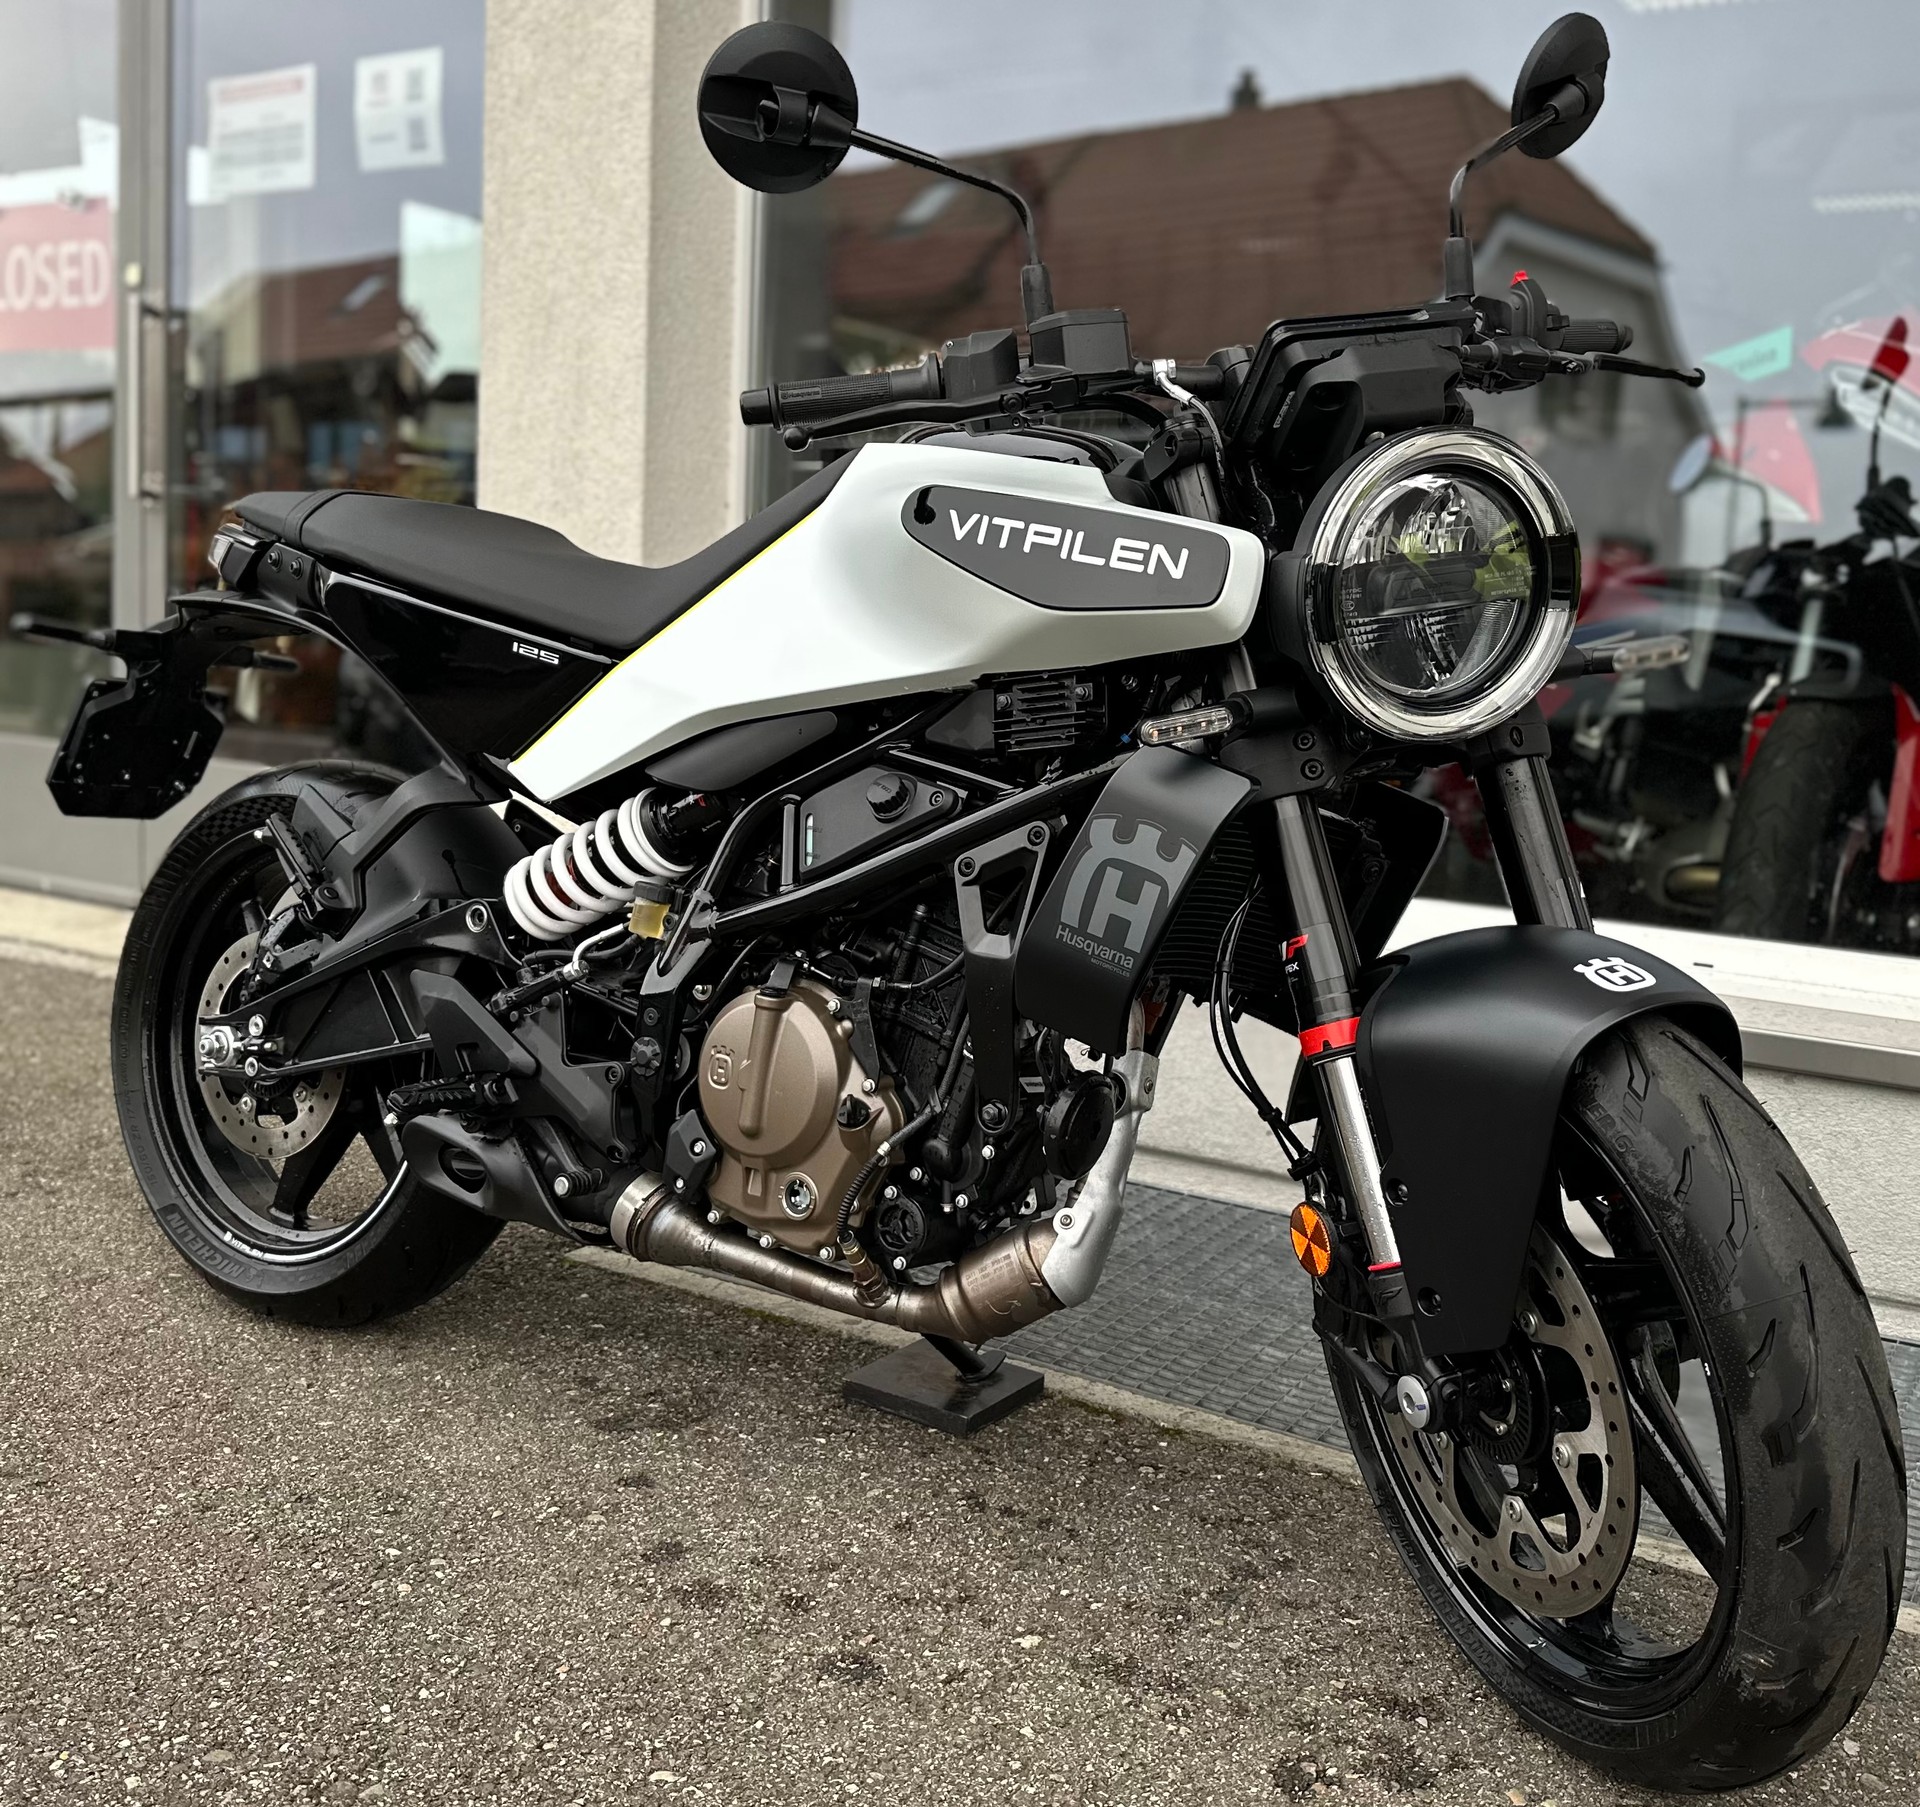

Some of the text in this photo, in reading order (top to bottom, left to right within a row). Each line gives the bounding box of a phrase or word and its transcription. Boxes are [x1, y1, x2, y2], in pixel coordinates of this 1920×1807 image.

[0, 240, 111, 310] OSED
[949, 509, 1189, 580] VITPILEN
[512, 641, 560, 665] 125
[1055, 924, 1135, 970] Husqvarna
[1090, 957, 1131, 978] MOTORCYCLES
[166, 1211, 246, 1279] MICHELIN
[1426, 1583, 1494, 1667] MICHELIN
